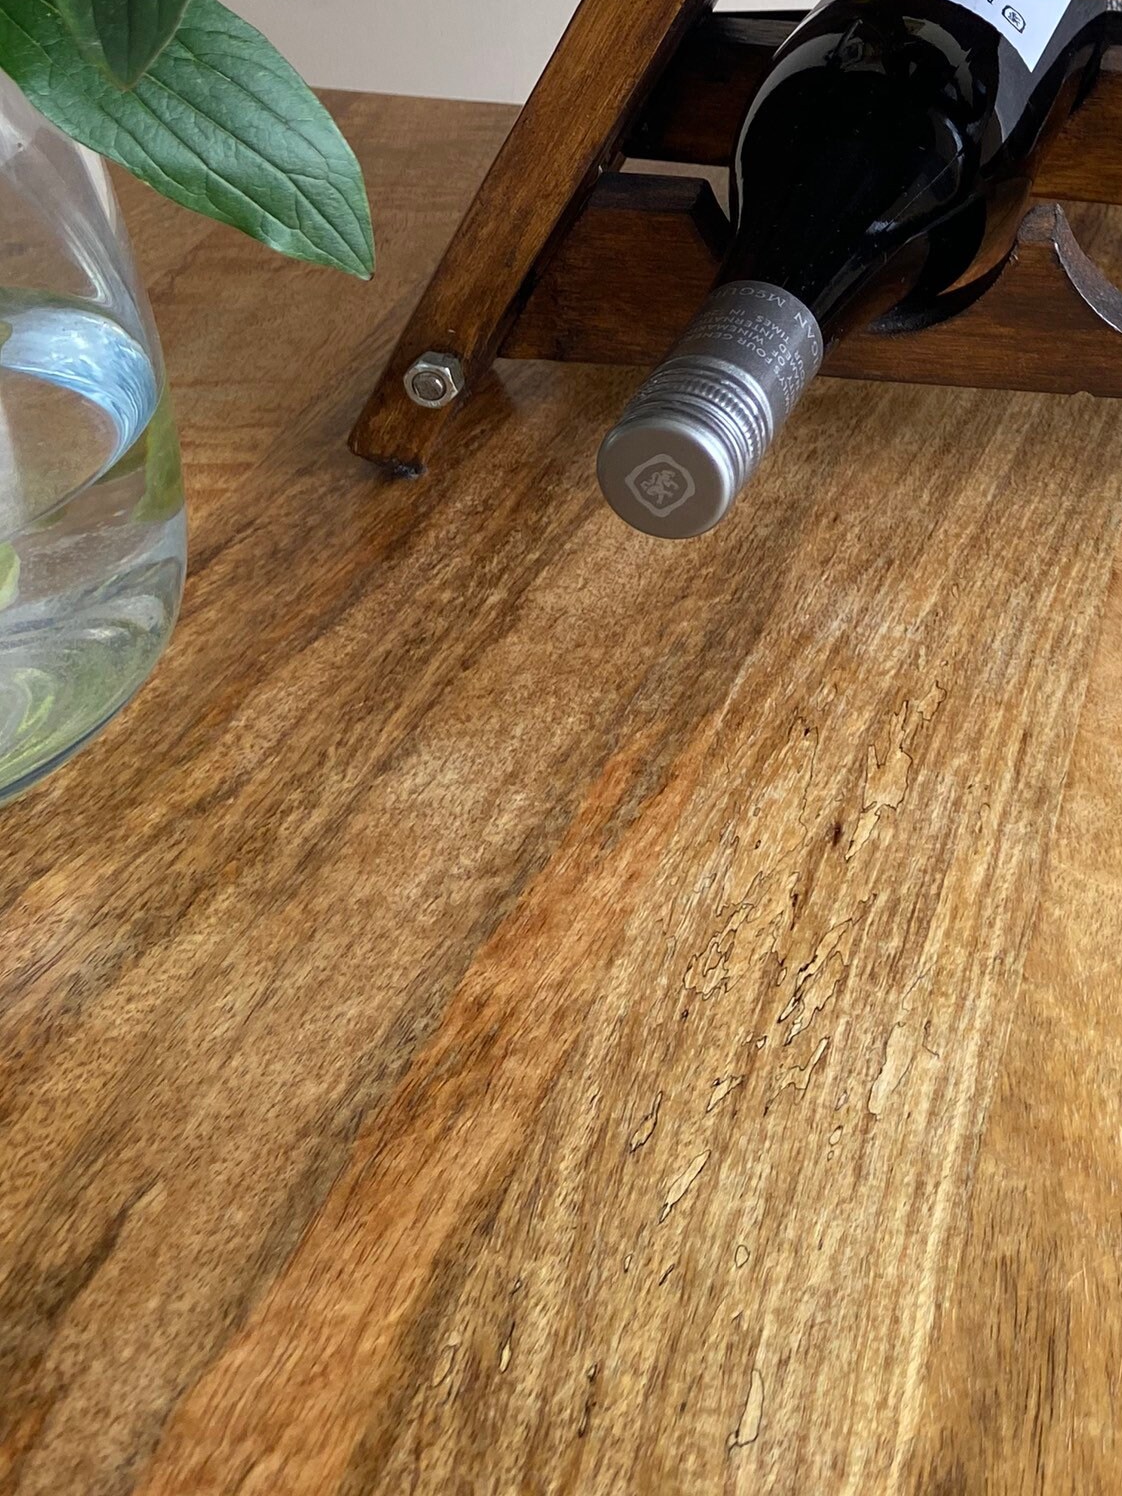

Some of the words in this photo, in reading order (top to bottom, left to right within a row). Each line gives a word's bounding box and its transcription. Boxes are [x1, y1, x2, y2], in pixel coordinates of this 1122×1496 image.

[755, 315, 789, 344] TIMES
[737, 338, 772, 364] FOUR
[772, 350, 785, 366] OF
